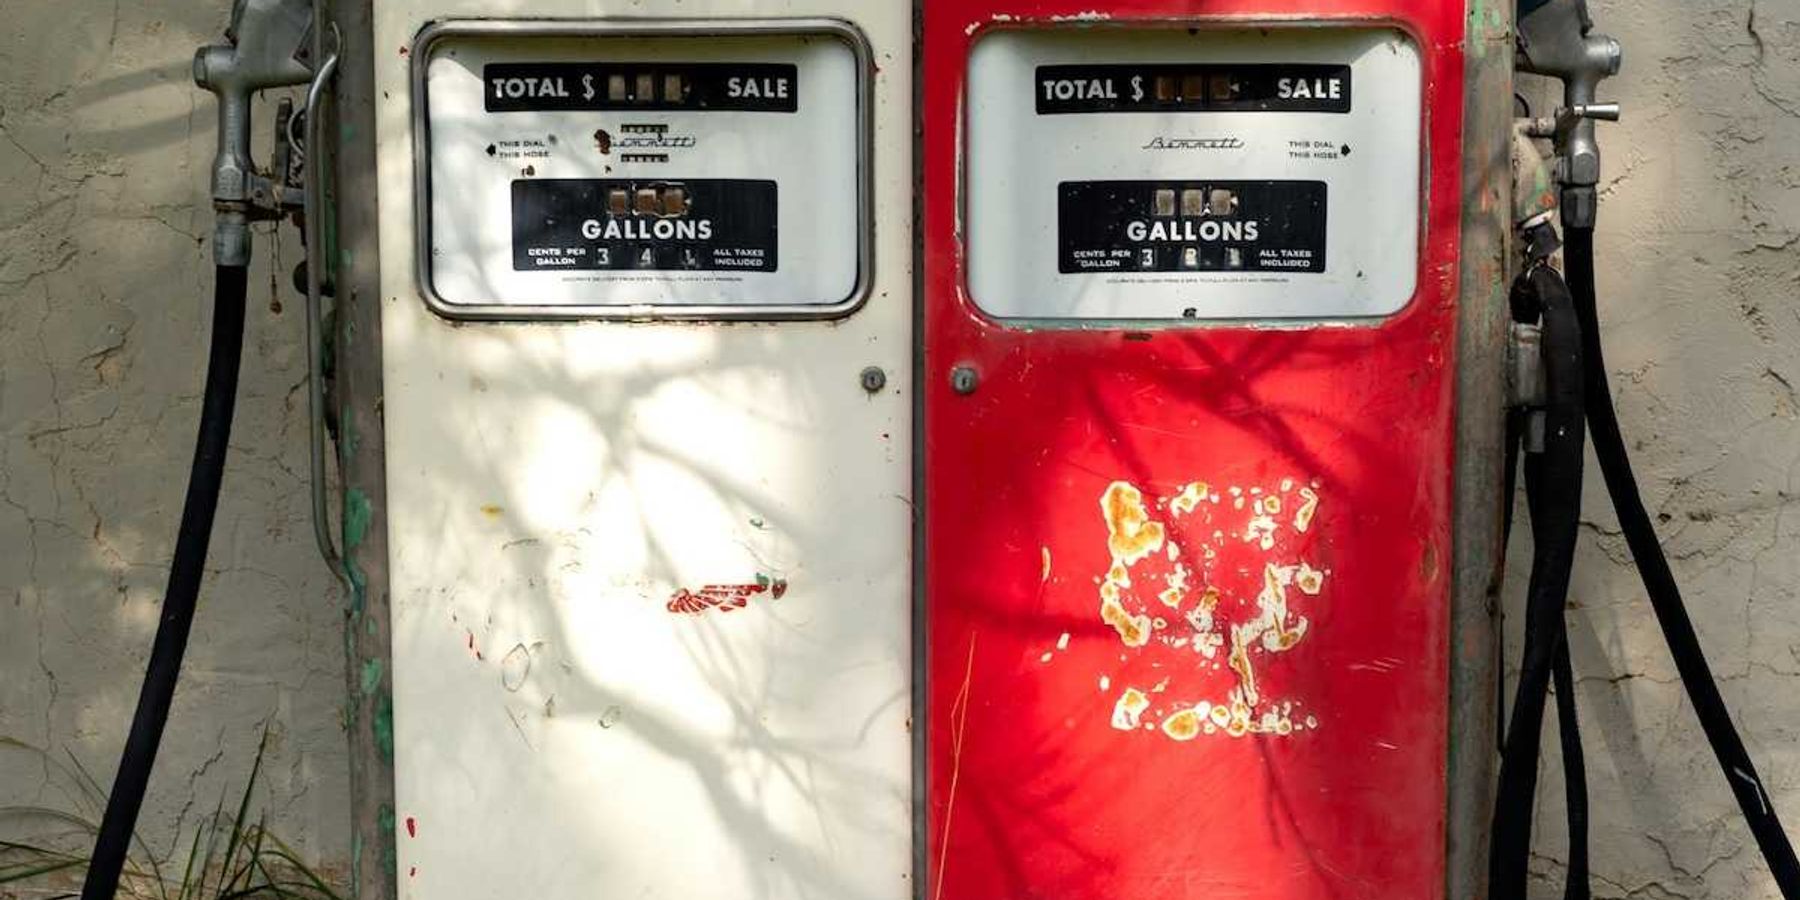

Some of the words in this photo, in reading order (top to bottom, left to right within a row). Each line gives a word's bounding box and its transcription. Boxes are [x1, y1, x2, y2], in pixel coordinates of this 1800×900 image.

[492, 77, 569, 99] TOTAL
[582, 73, 595, 100] $
[728, 77, 789, 99] SALE
[1043, 79, 1117, 99] TOTAL
[1131, 75, 1144, 102] $
[1277, 78, 1341, 99] SALE
[582, 219, 712, 240] GALLONS
[1127, 221, 1259, 241] GALLONS
[528, 248, 560, 257] CENTS
[566, 248, 586, 256] PER
[597, 247, 610, 265] 3
[640, 247, 652, 265] 4
[713, 249, 732, 257] ALL
[734, 249, 764, 257] TAXES
[1074, 250, 1106, 259] CENTS
[1111, 250, 1131, 258] PER
[1141, 248, 1153, 266] 3
[1259, 249, 1278, 258] ALL
[1280, 249, 1312, 258] TAXES
[536, 257, 576, 265] GALLON
[715, 258, 763, 267] INCLUDED
[1080, 259, 1120, 267] GALLON
[1260, 259, 1310, 267] INCLUDED
